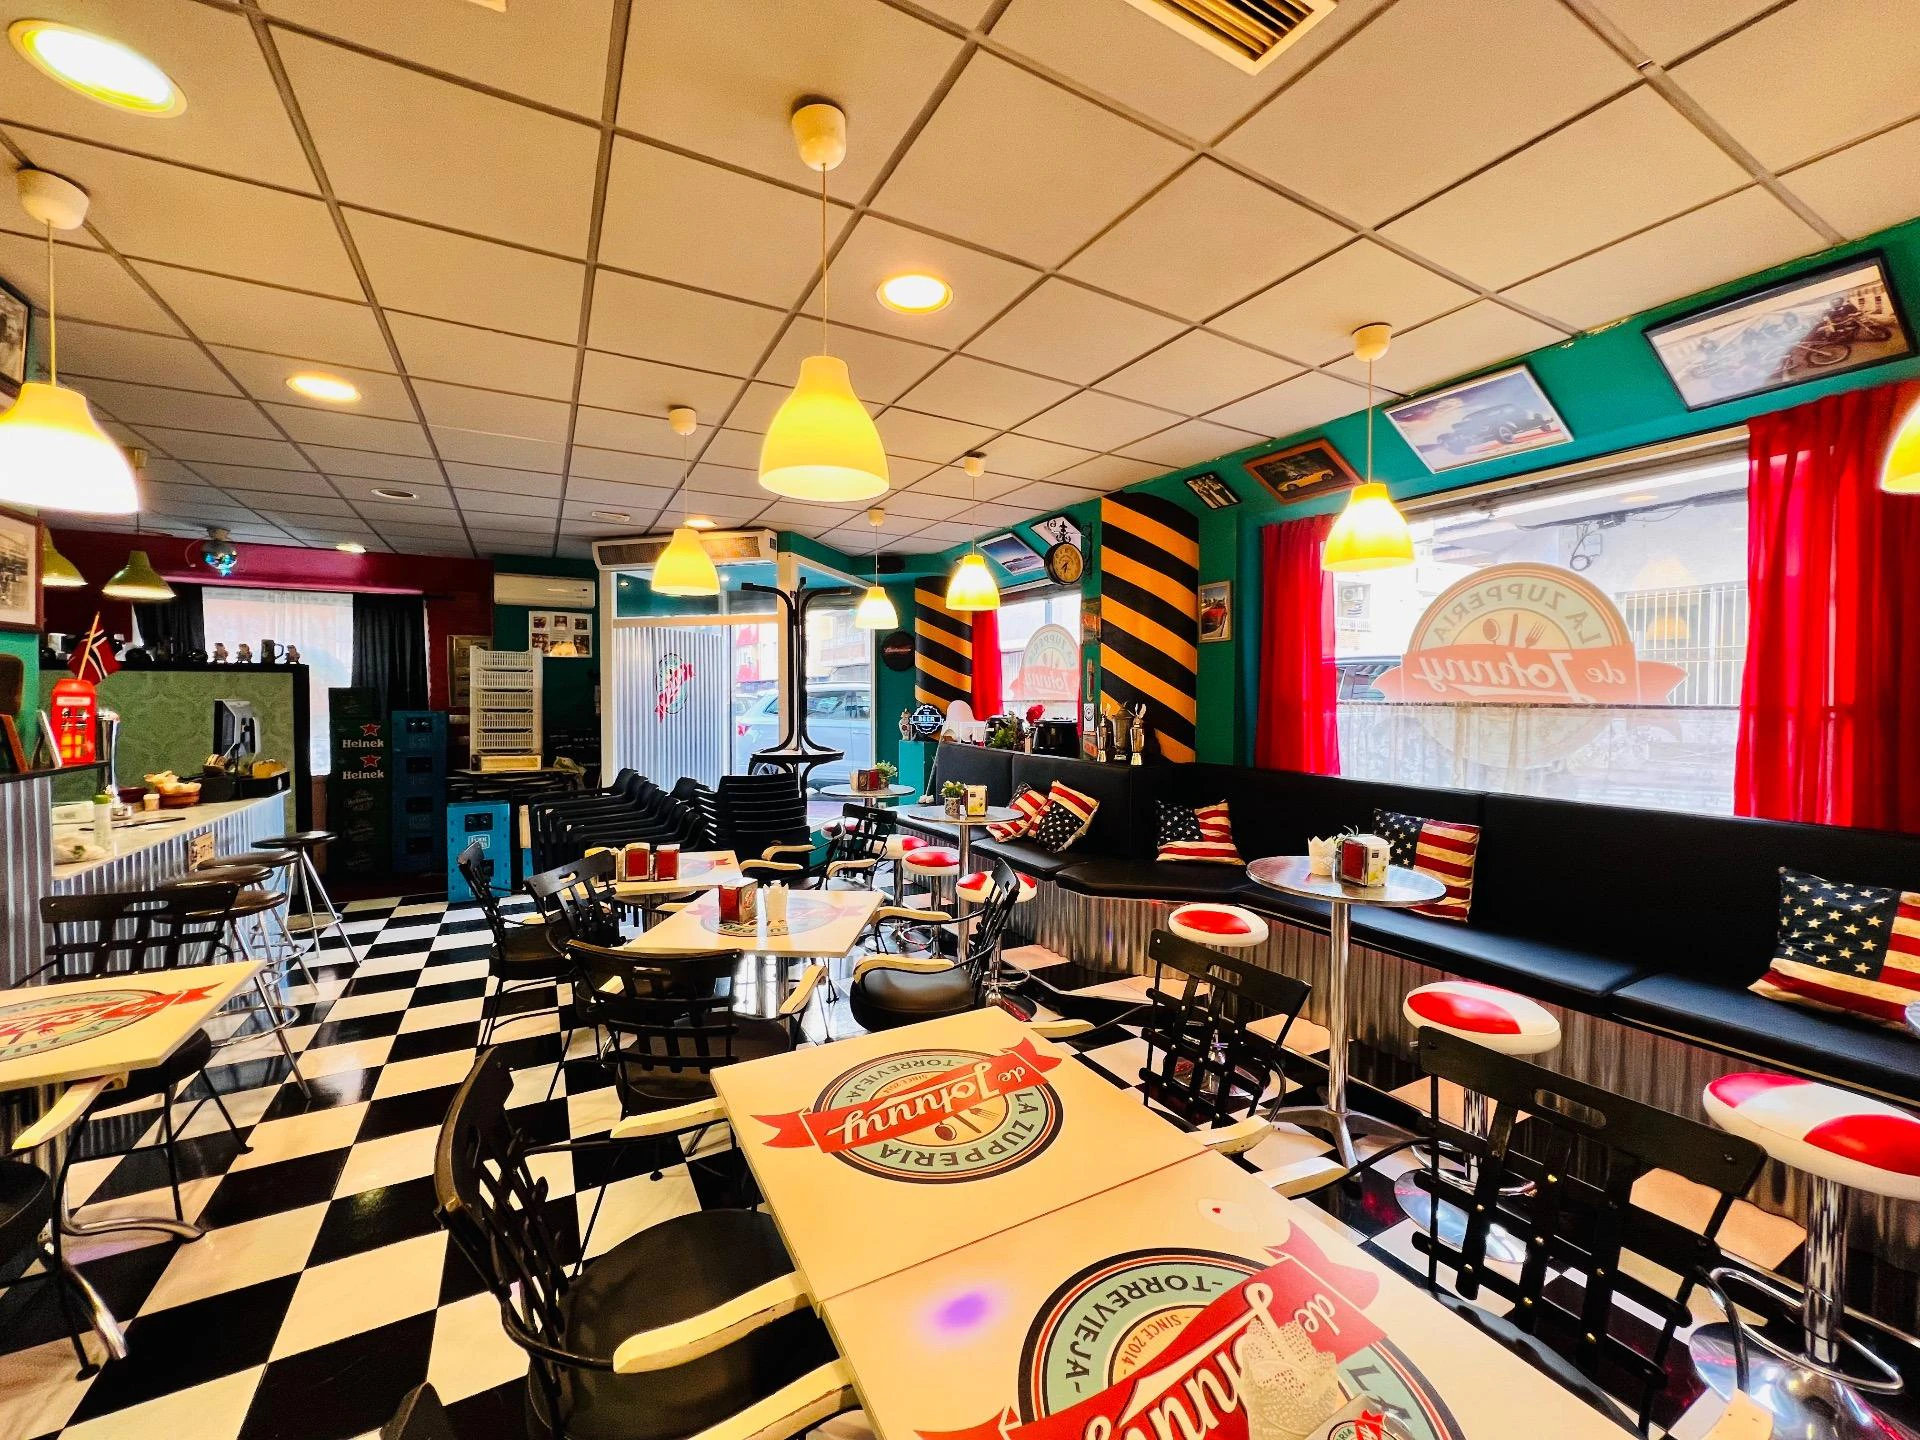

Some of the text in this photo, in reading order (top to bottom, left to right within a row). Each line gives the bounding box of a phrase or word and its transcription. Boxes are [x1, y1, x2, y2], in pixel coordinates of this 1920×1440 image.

[826, 1062, 1027, 1144] de Johnny
[879, 1092, 1039, 1167] LA ZUPPERIA
[1121, 1314, 1182, 1366] SINCE 2014
[1294, 1293, 1341, 1336] de
